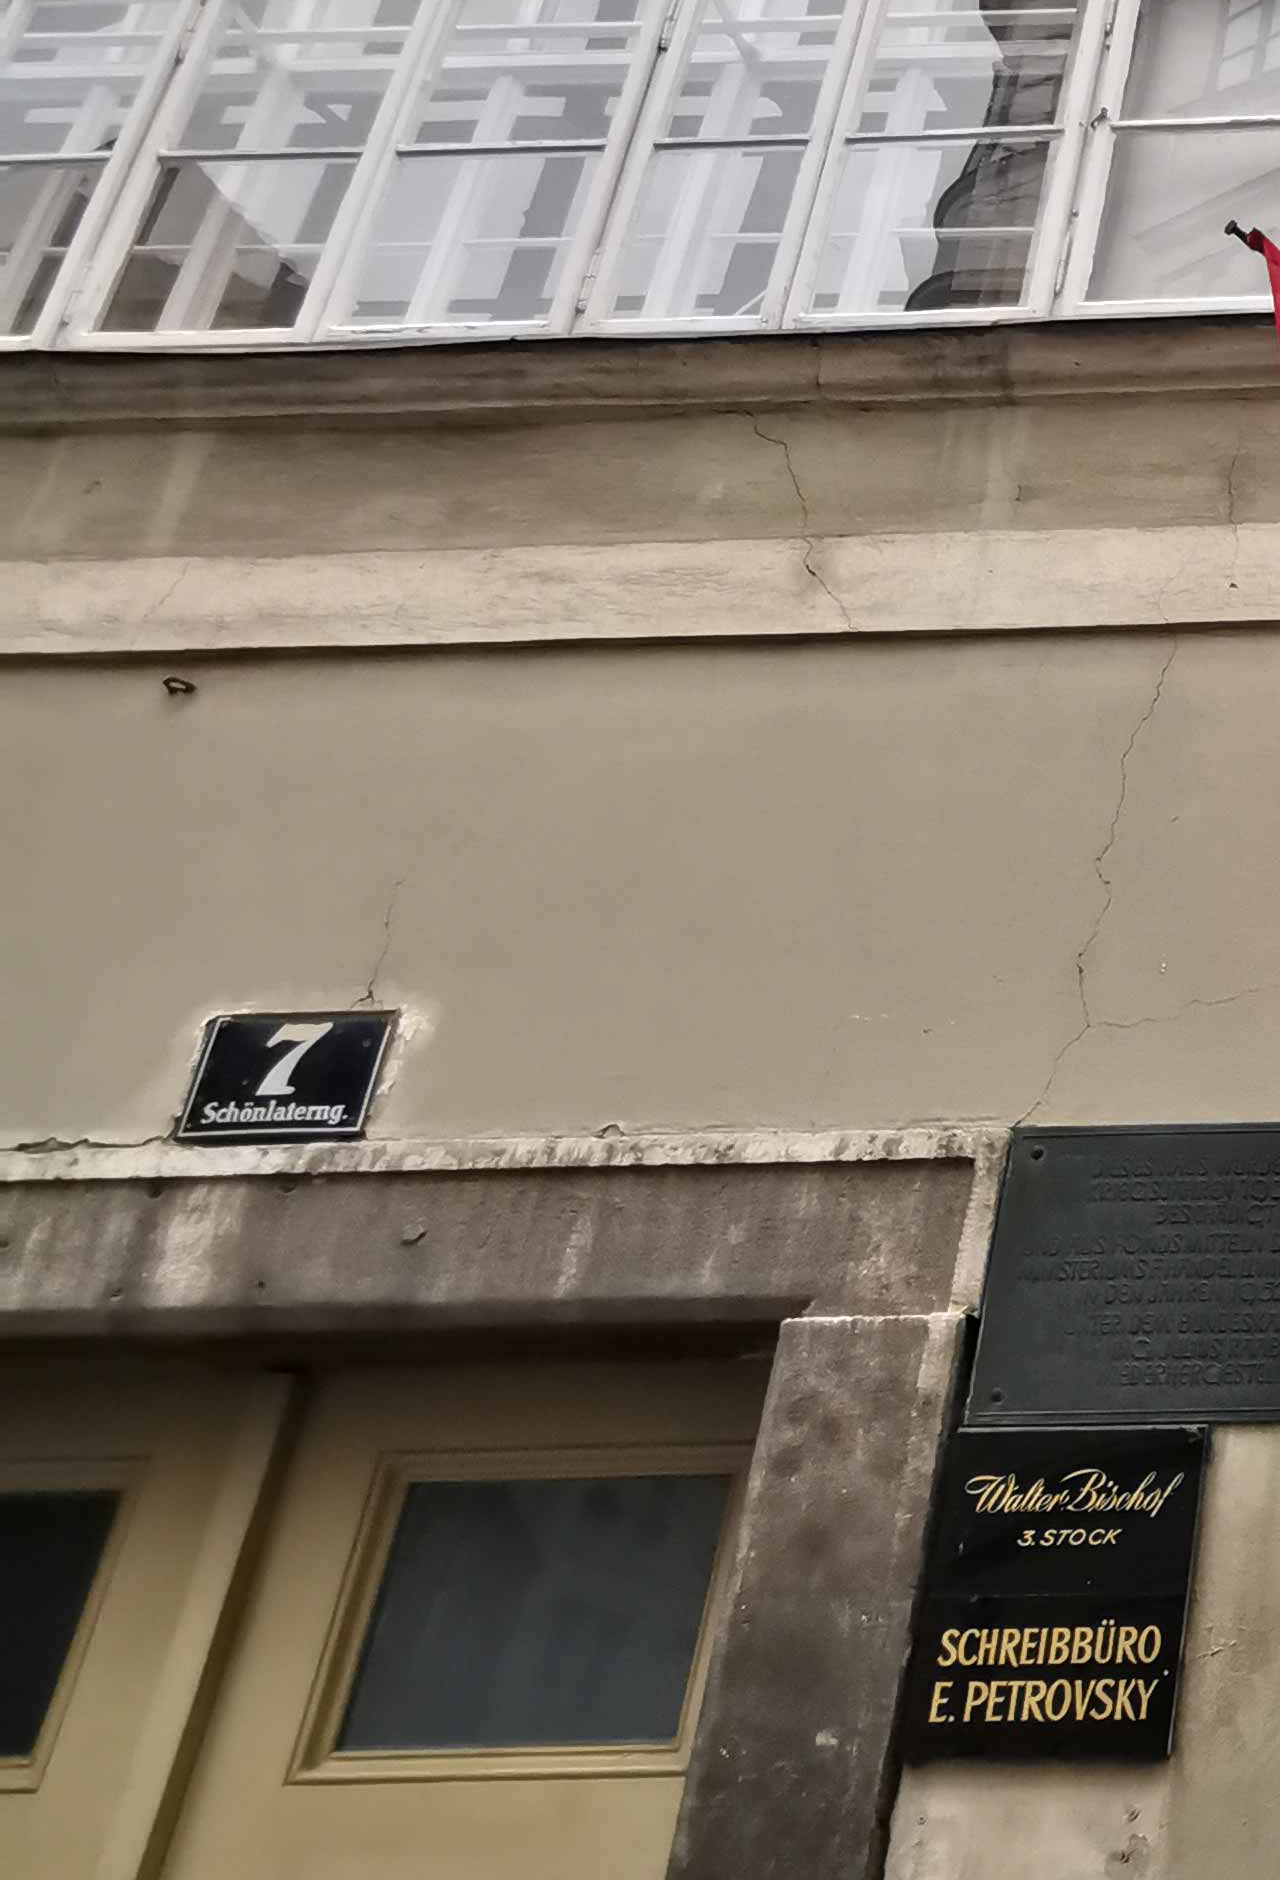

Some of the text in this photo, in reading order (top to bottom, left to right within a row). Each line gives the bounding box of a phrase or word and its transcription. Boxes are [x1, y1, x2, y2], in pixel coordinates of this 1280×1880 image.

[255, 1022, 334, 1096] 7
[200, 1100, 350, 1125] Schönlaterng.
[964, 1468, 1185, 1518] Walter Bischof
[1039, 1528, 1123, 1546] STOCK
[937, 1618, 1162, 1668] SCHREIBBÜRO
[928, 1678, 1159, 1724] E. PETROVSKY
